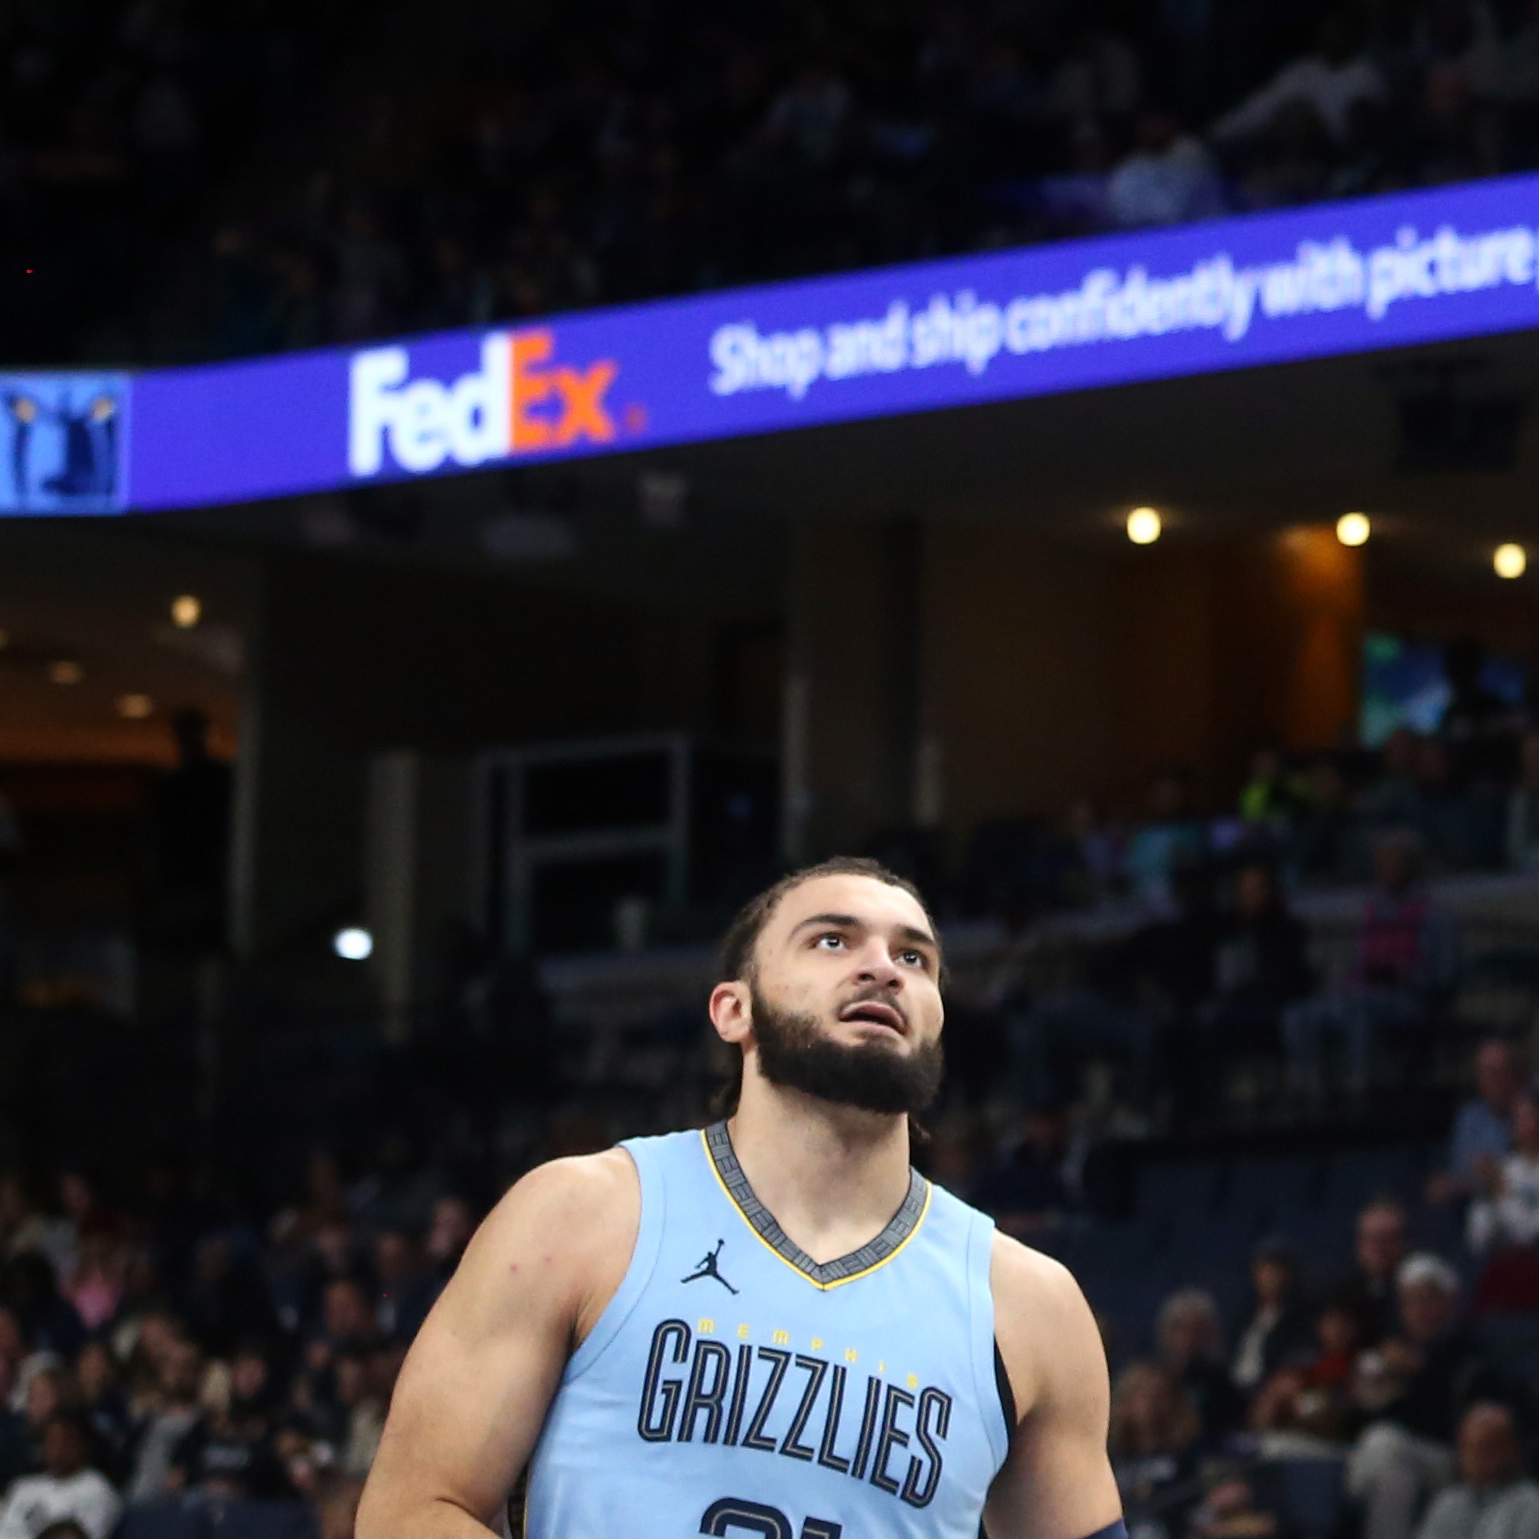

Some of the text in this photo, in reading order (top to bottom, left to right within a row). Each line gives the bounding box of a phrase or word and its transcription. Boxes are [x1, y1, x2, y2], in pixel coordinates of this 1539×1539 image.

[710, 319, 821, 400] Shop
[826, 301, 908, 380] and
[911, 290, 1001, 375] ship
[1003, 255, 1254, 344] confidently
[1260, 235, 1362, 317] with
[1366, 227, 1534, 320] picture
[350, 329, 619, 478] FedEx
[637, 1318, 952, 1509] GRIZZLIES
[697, 1318, 918, 1390] MEMPHIS
